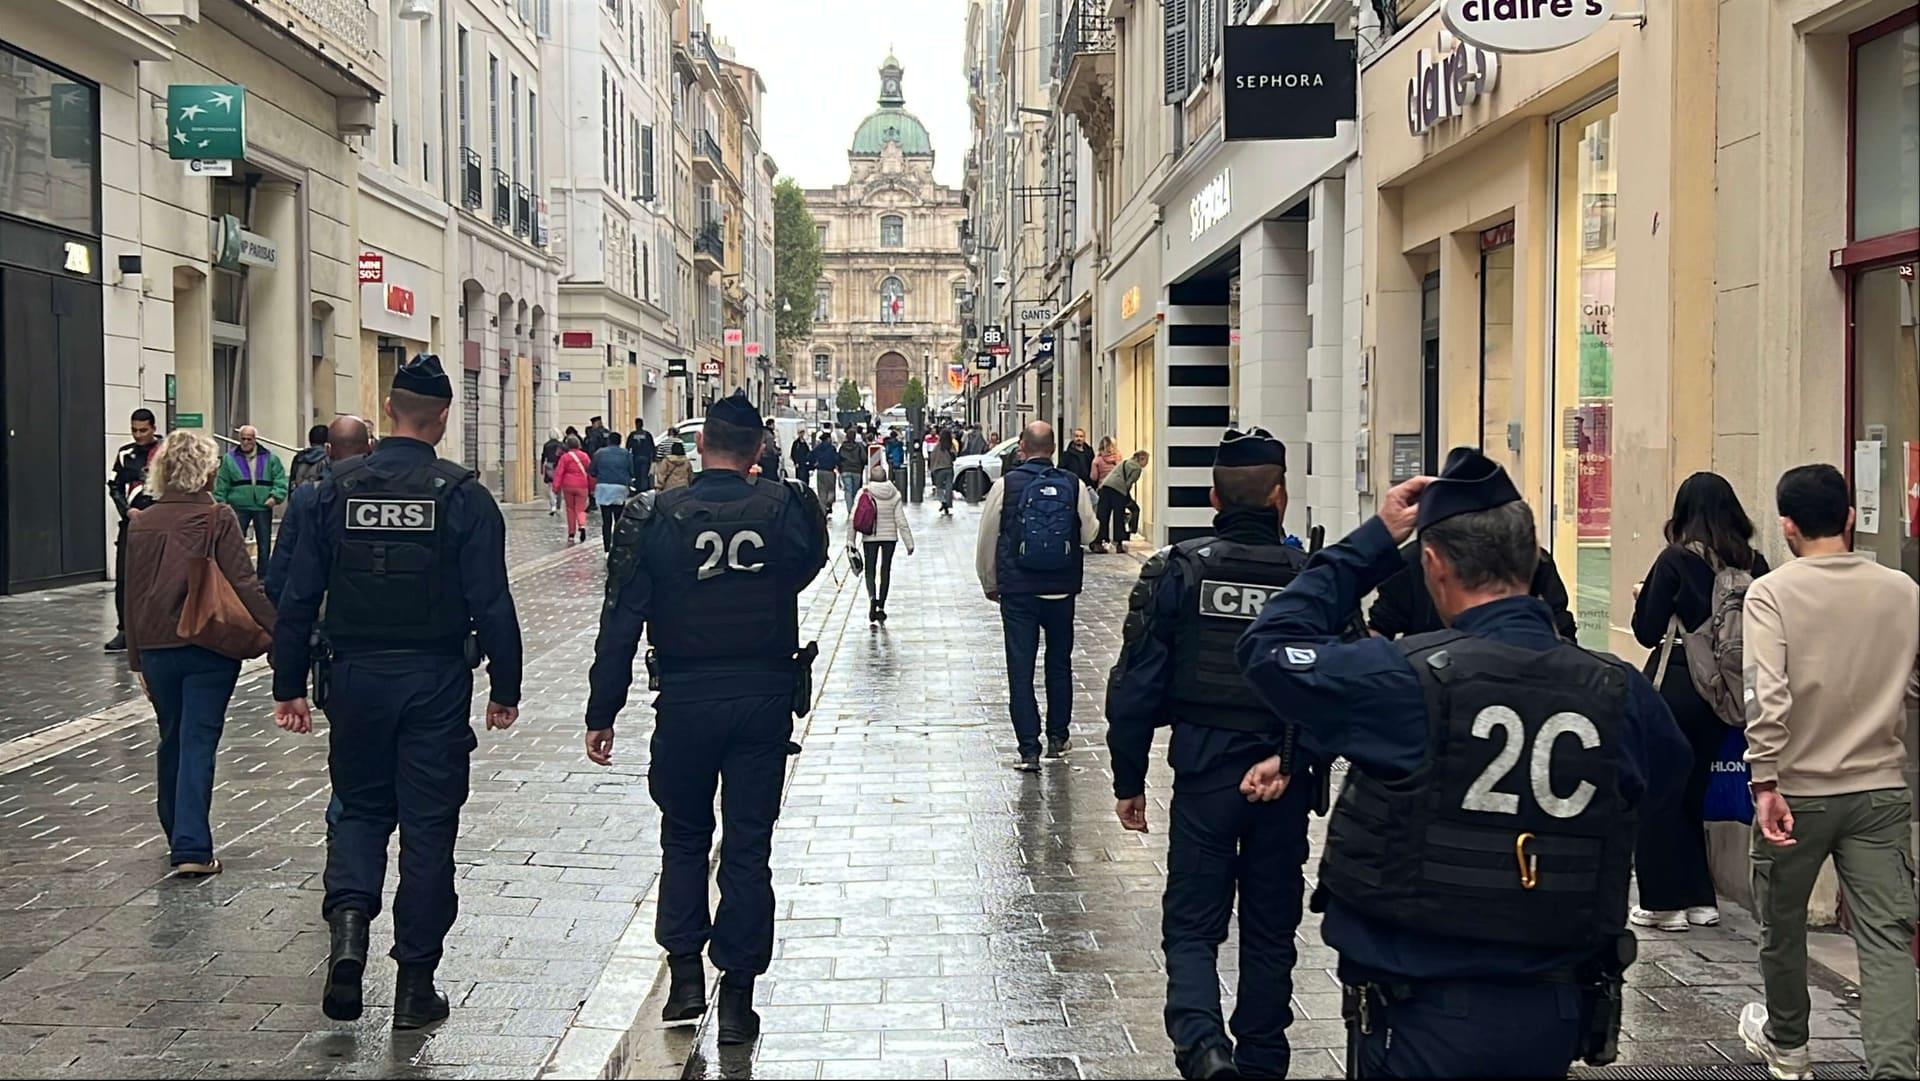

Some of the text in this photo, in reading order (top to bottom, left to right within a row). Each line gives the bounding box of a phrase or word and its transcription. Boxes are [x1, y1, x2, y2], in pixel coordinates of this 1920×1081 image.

[1236, 73, 1324, 88] SEPHORA
[359, 261, 381, 269] MINI
[1021, 310, 1051, 320] GANTS
[1580, 300, 1615, 318] cin
[356, 504, 425, 527] CRS
[695, 530, 765, 580] 2C
[1212, 586, 1283, 615] CR
[1461, 705, 1601, 819] 2C
[1710, 761, 1747, 773] HLON
